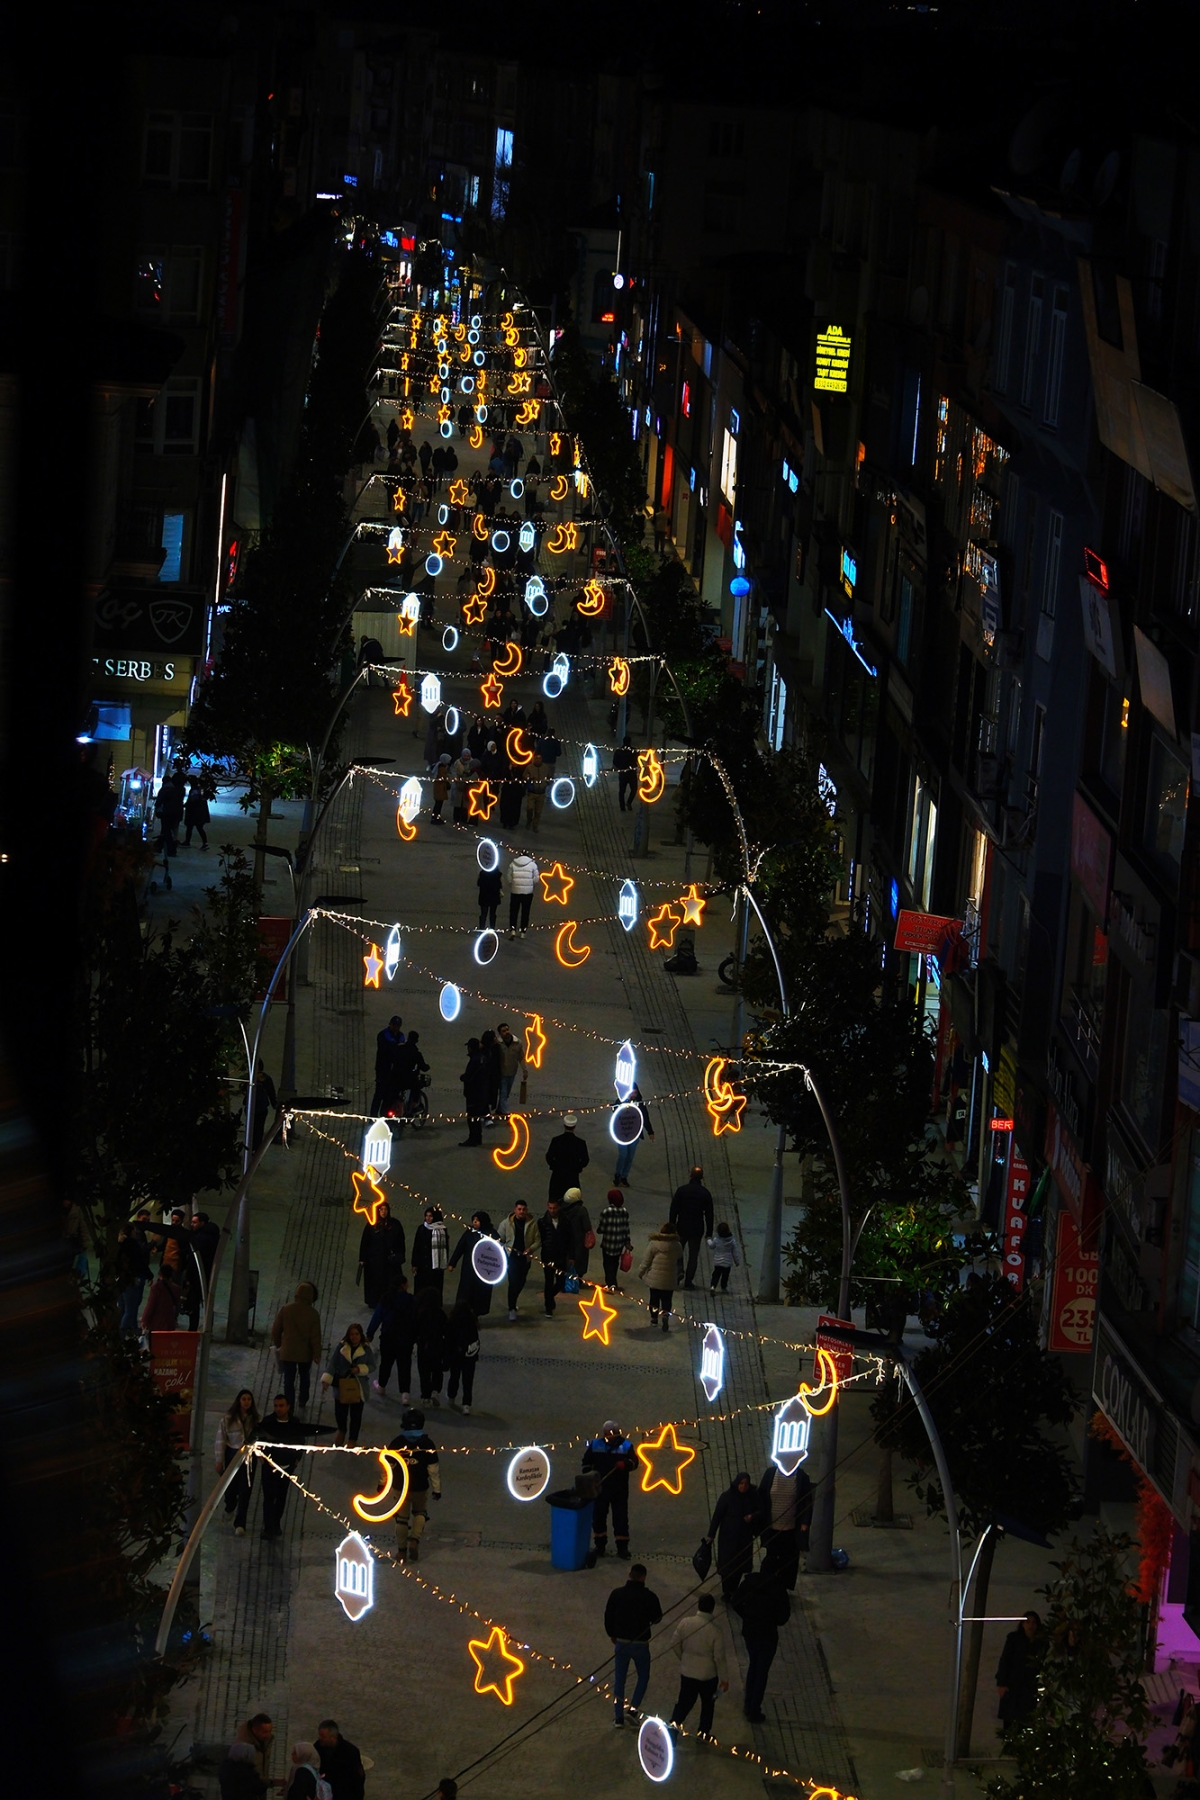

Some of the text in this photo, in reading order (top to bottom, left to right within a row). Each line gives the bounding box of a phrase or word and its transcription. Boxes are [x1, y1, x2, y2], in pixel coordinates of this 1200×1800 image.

[826, 325, 843, 336] ADA
[1076, 1285, 1093, 1295] DK
[1076, 1331, 1090, 1342] TL
